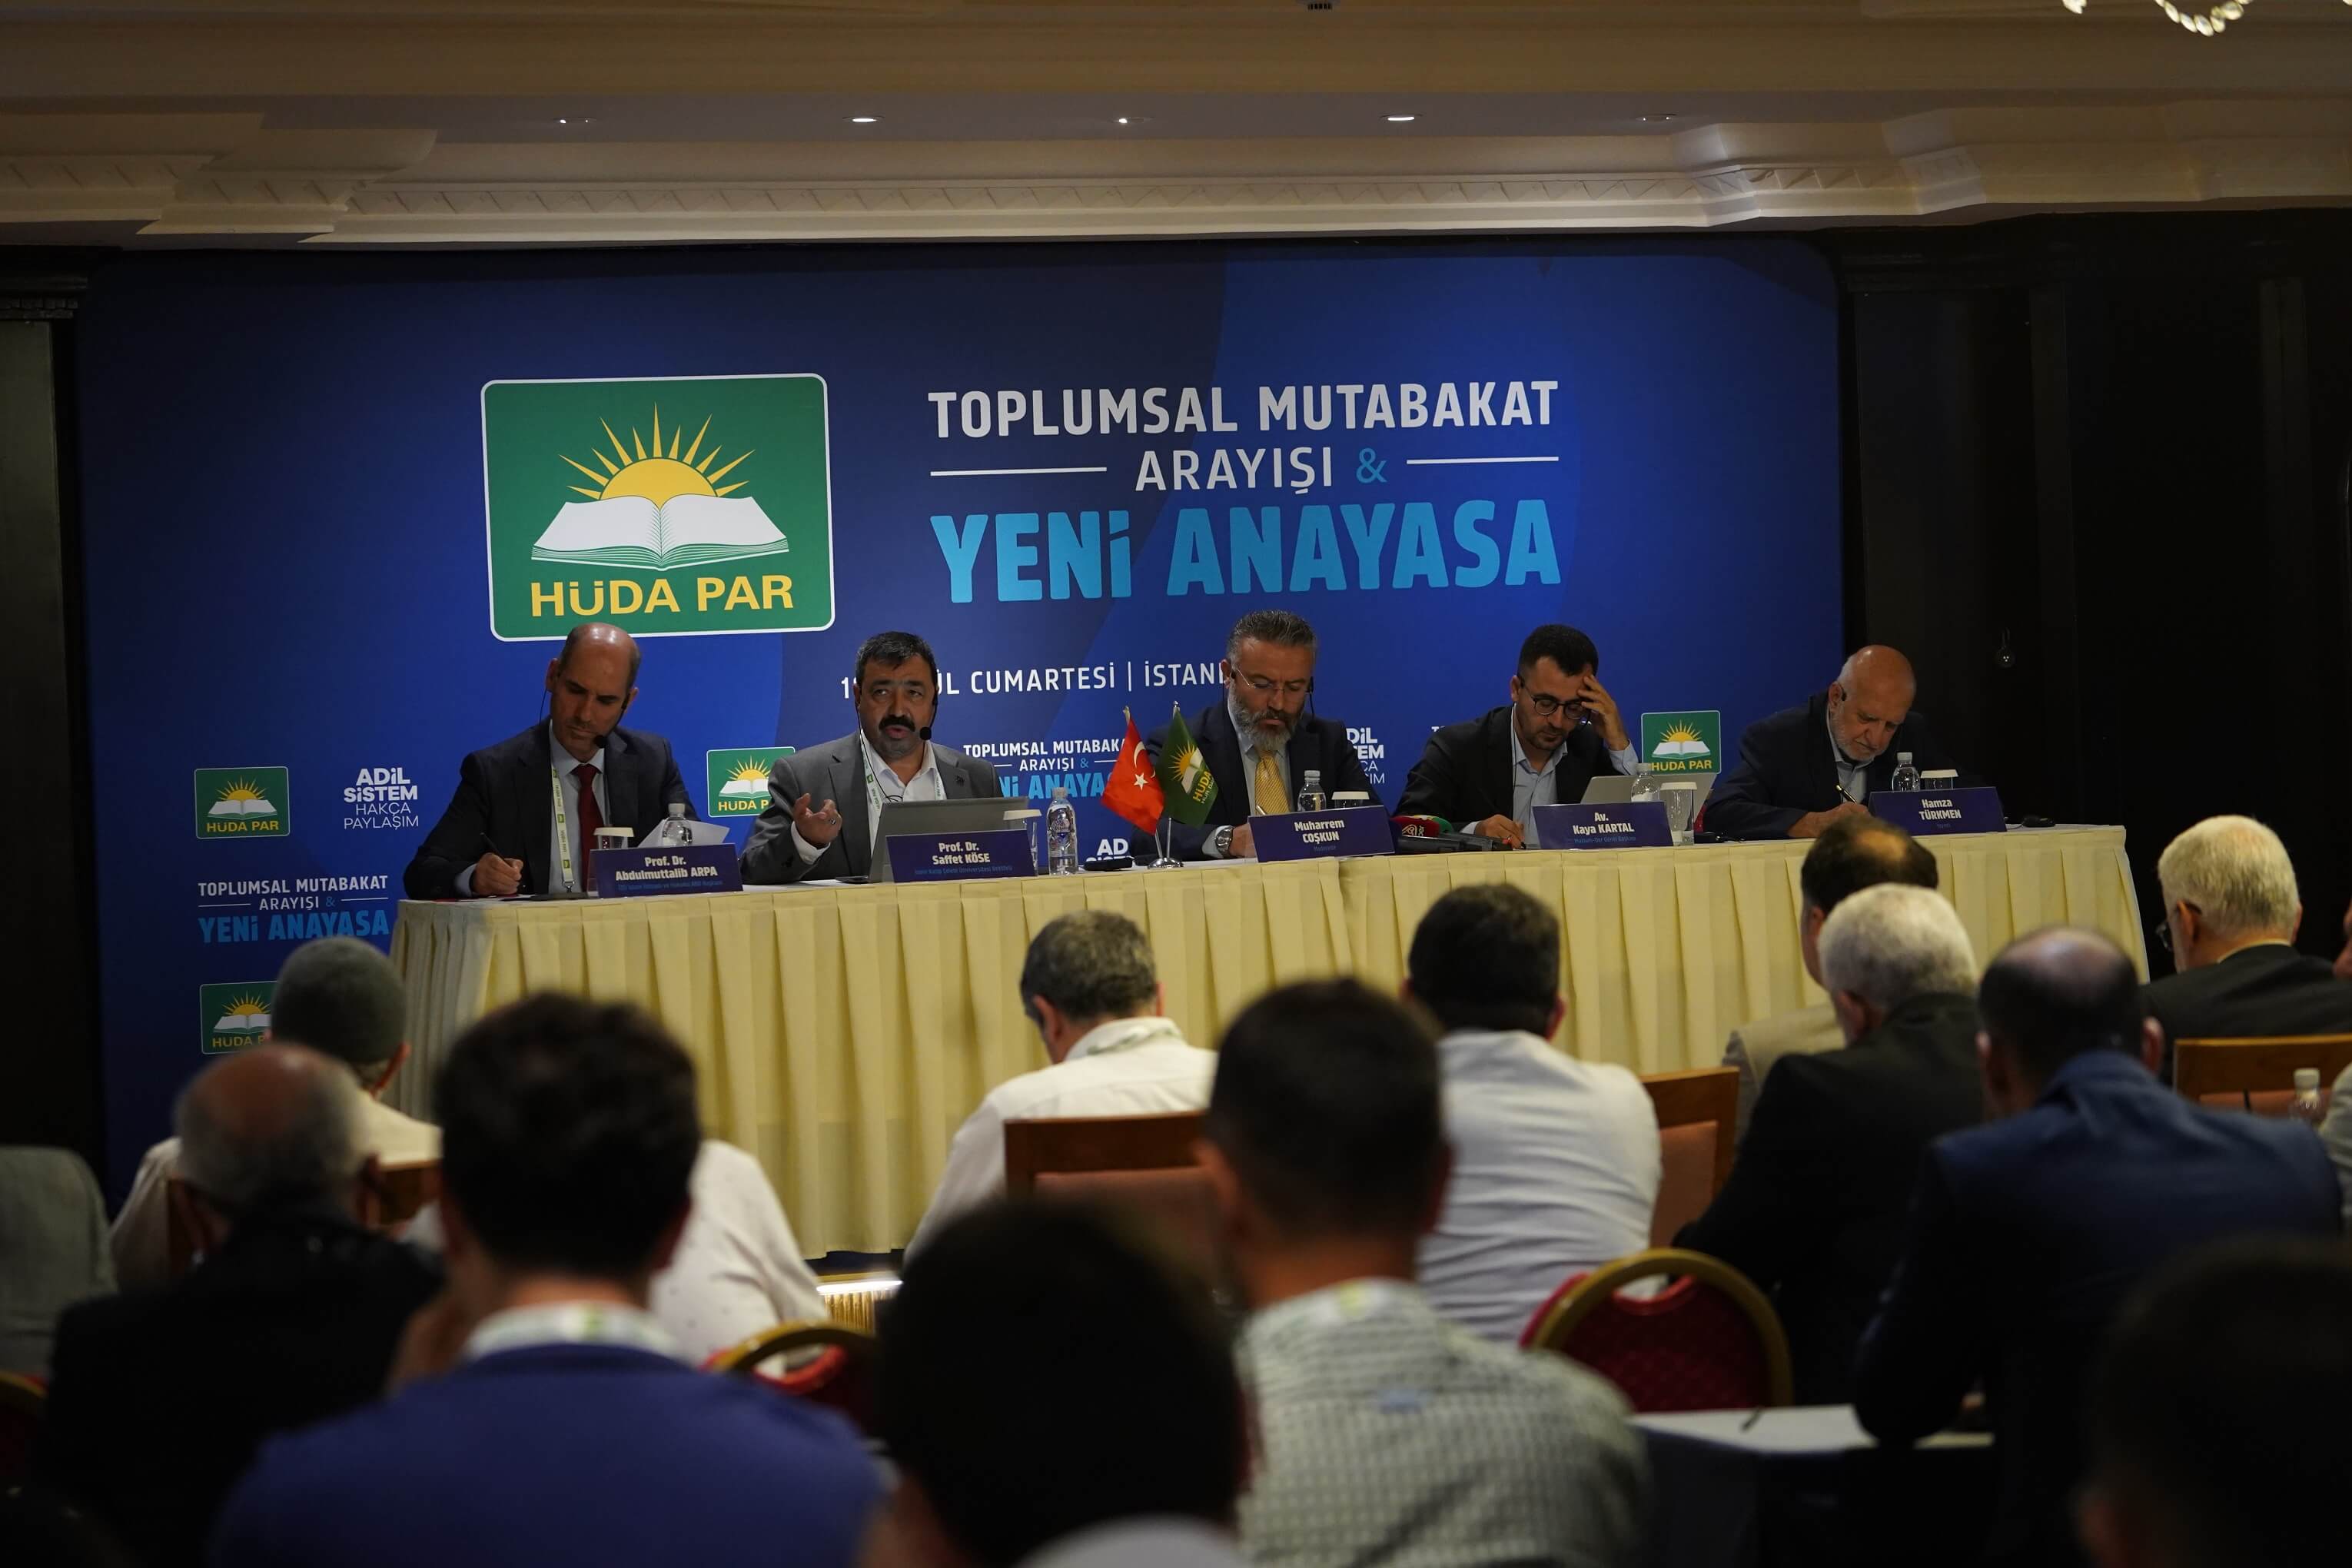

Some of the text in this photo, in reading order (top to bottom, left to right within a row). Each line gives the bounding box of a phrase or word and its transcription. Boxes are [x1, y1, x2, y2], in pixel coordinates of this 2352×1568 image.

[928, 380, 1559, 438] TOPLUMSAL MUTABAKAT
[1135, 447, 1387, 494] ARAYIŞI &
[1166, 499, 1561, 596] ANAYASA
[531, 574, 794, 616] HÜDA PAR
[841, 676, 857, 699] 1
[971, 662, 1115, 694] CUMARTESİ
[1144, 660, 1224, 686] İSTAN
[963, 738, 1125, 757] TOPLUMSAL MUTABAK
[1019, 758, 1089, 772] ARAYIŞI &
[1689, 759, 1713, 769] PAR
[1028, 772, 1111, 800] ANAYA
[356, 802, 411, 817] HAKÇA
[718, 799, 757, 811] HÜDA
[1922, 799, 1953, 809] Hamza
[1594, 812, 1609, 822] Av.
[1918, 809, 1962, 820] TÜRKMEN
[206, 820, 279, 832] HÜDA PAR
[344, 816, 419, 830] PAYLAŞIM
[1294, 819, 1345, 832] Muharrem
[1573, 822, 1635, 835] Kaya KARTAL
[1302, 831, 1340, 844] COŞKUN
[938, 842, 979, 852] Prof. Dr.
[1096, 838, 1129, 855] AD
[645, 855, 686, 867] Prof. Dr.
[932, 852, 990, 865] Saffet KÖSE
[616, 866, 718, 881] Abdulmuttalib ARPA
[198, 875, 388, 896] TOPLUMSAL MUTABAKAT
[259, 896, 336, 911] ARAYIŞI &
[267, 909, 390, 941] ANAYASA
